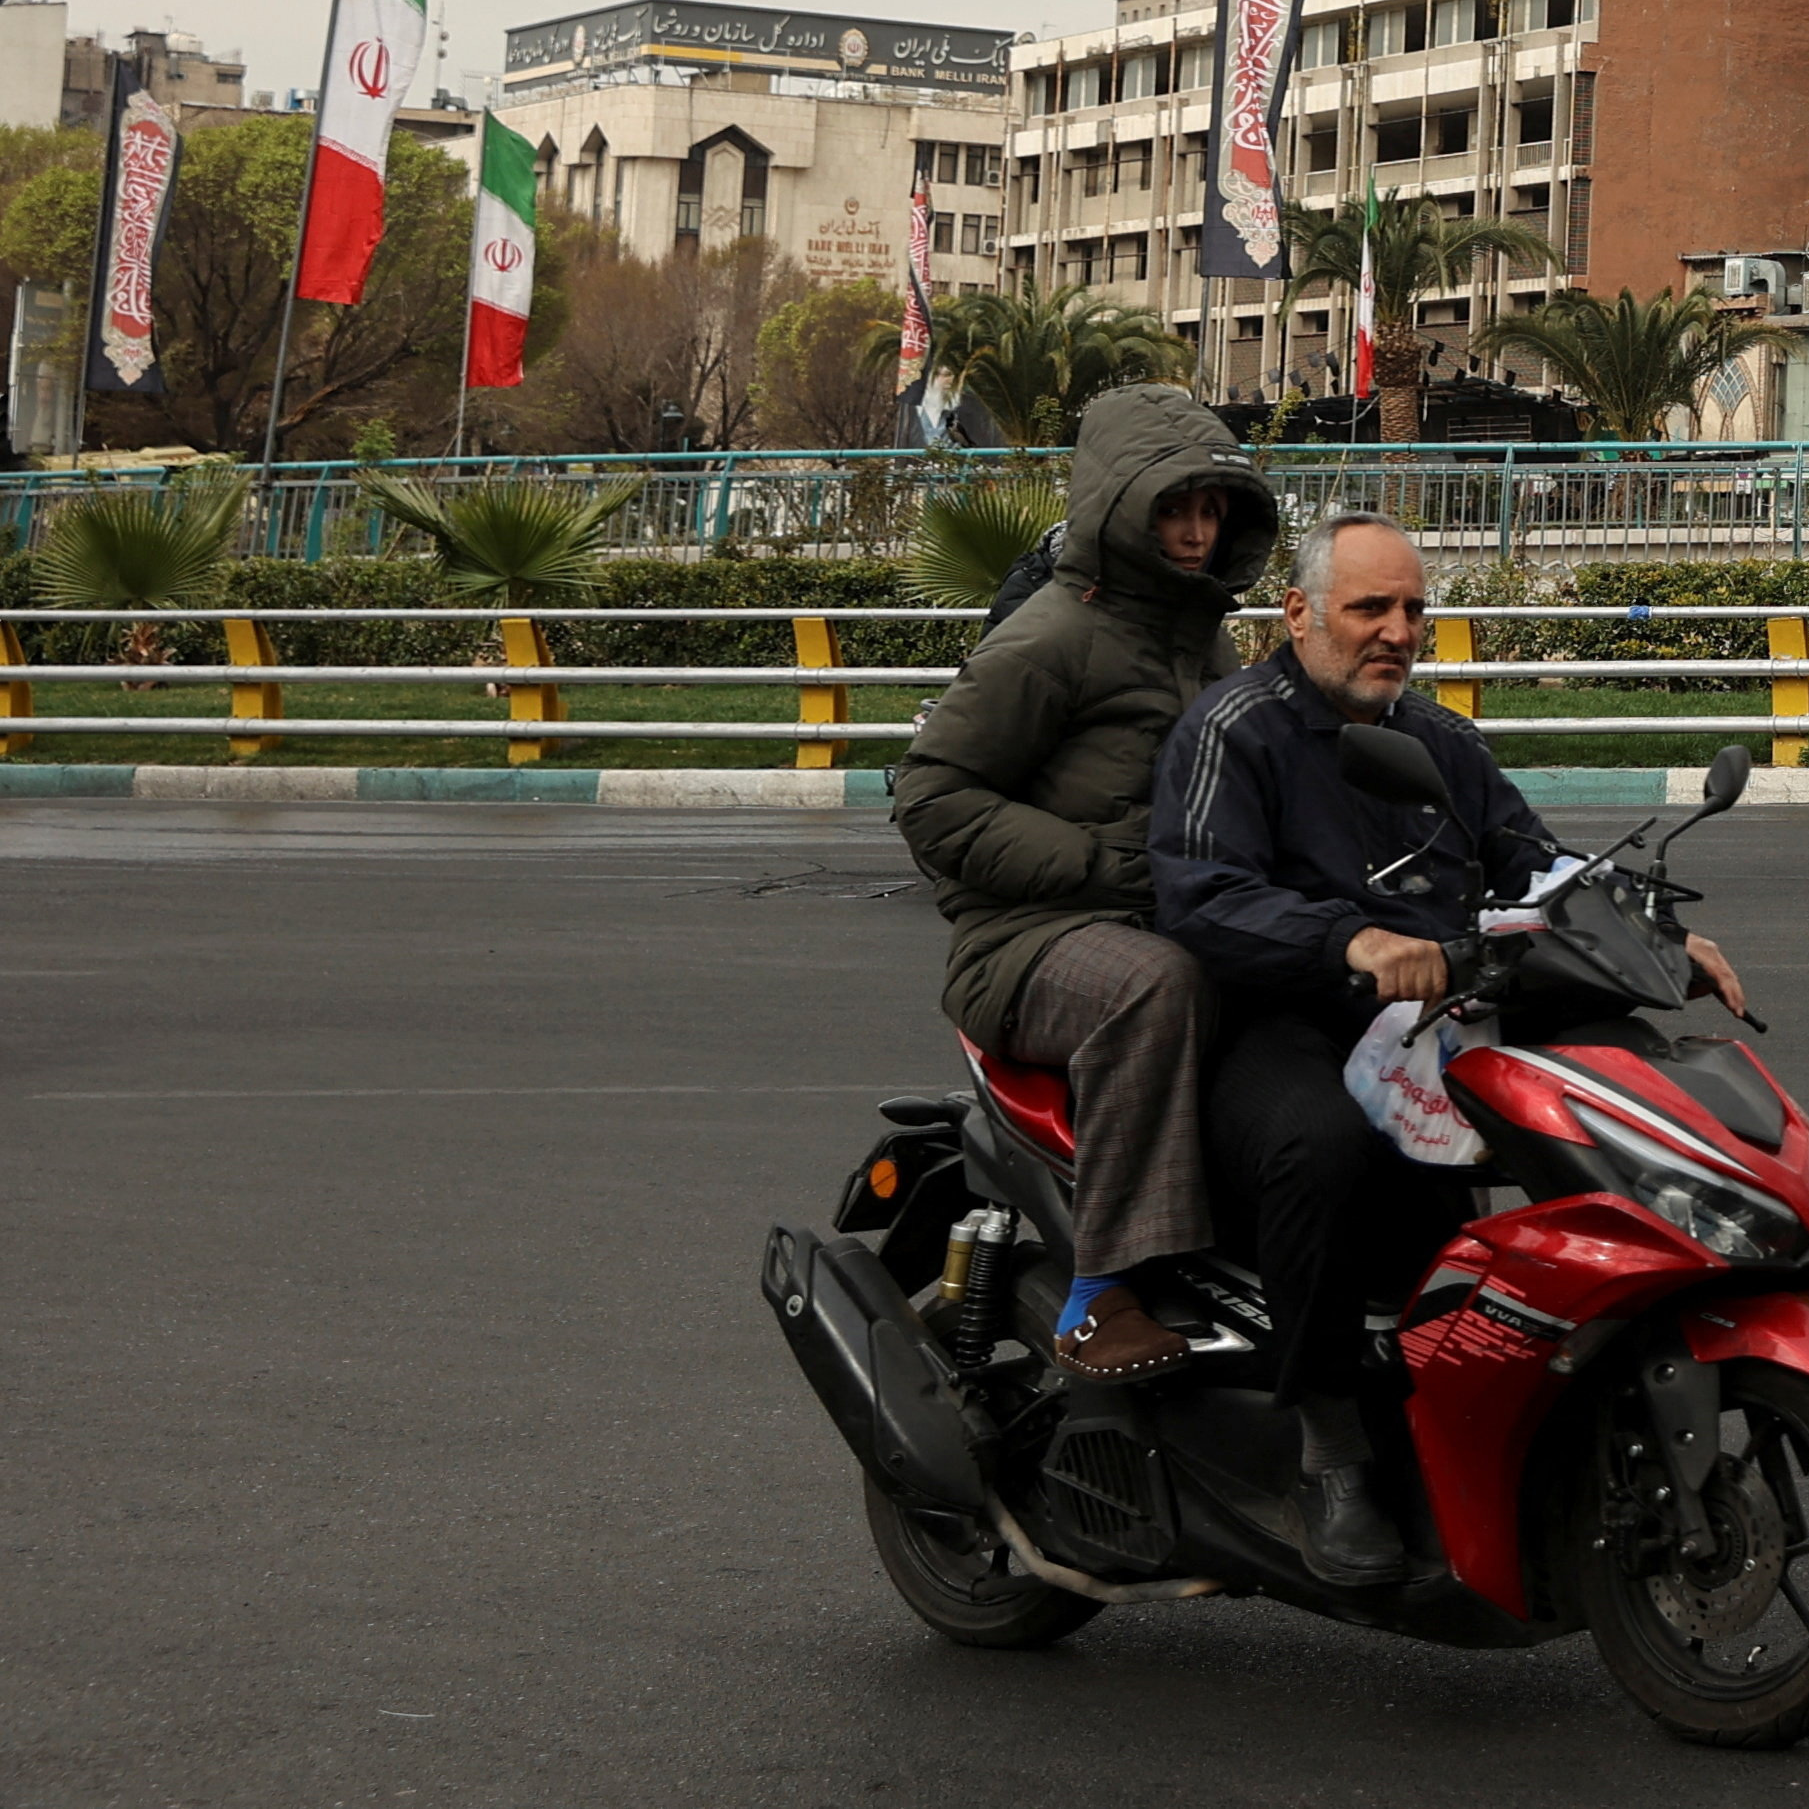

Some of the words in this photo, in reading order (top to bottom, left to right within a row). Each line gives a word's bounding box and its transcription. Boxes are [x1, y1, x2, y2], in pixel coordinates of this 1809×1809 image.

[653, 7, 690, 36] روشها
[692, 24, 701, 38] و
[703, 22, 756, 42] سازمان
[758, 15, 791, 52] کل
[787, 31, 826, 48] اداره
[893, 37, 933, 66] ایران
[930, 33, 951, 65] ملی
[950, 36, 1014, 73] بانک
[890, 65, 926, 79] BANK
[934, 70, 973, 83] MELLI
[975, 73, 1008, 86] IRAN
